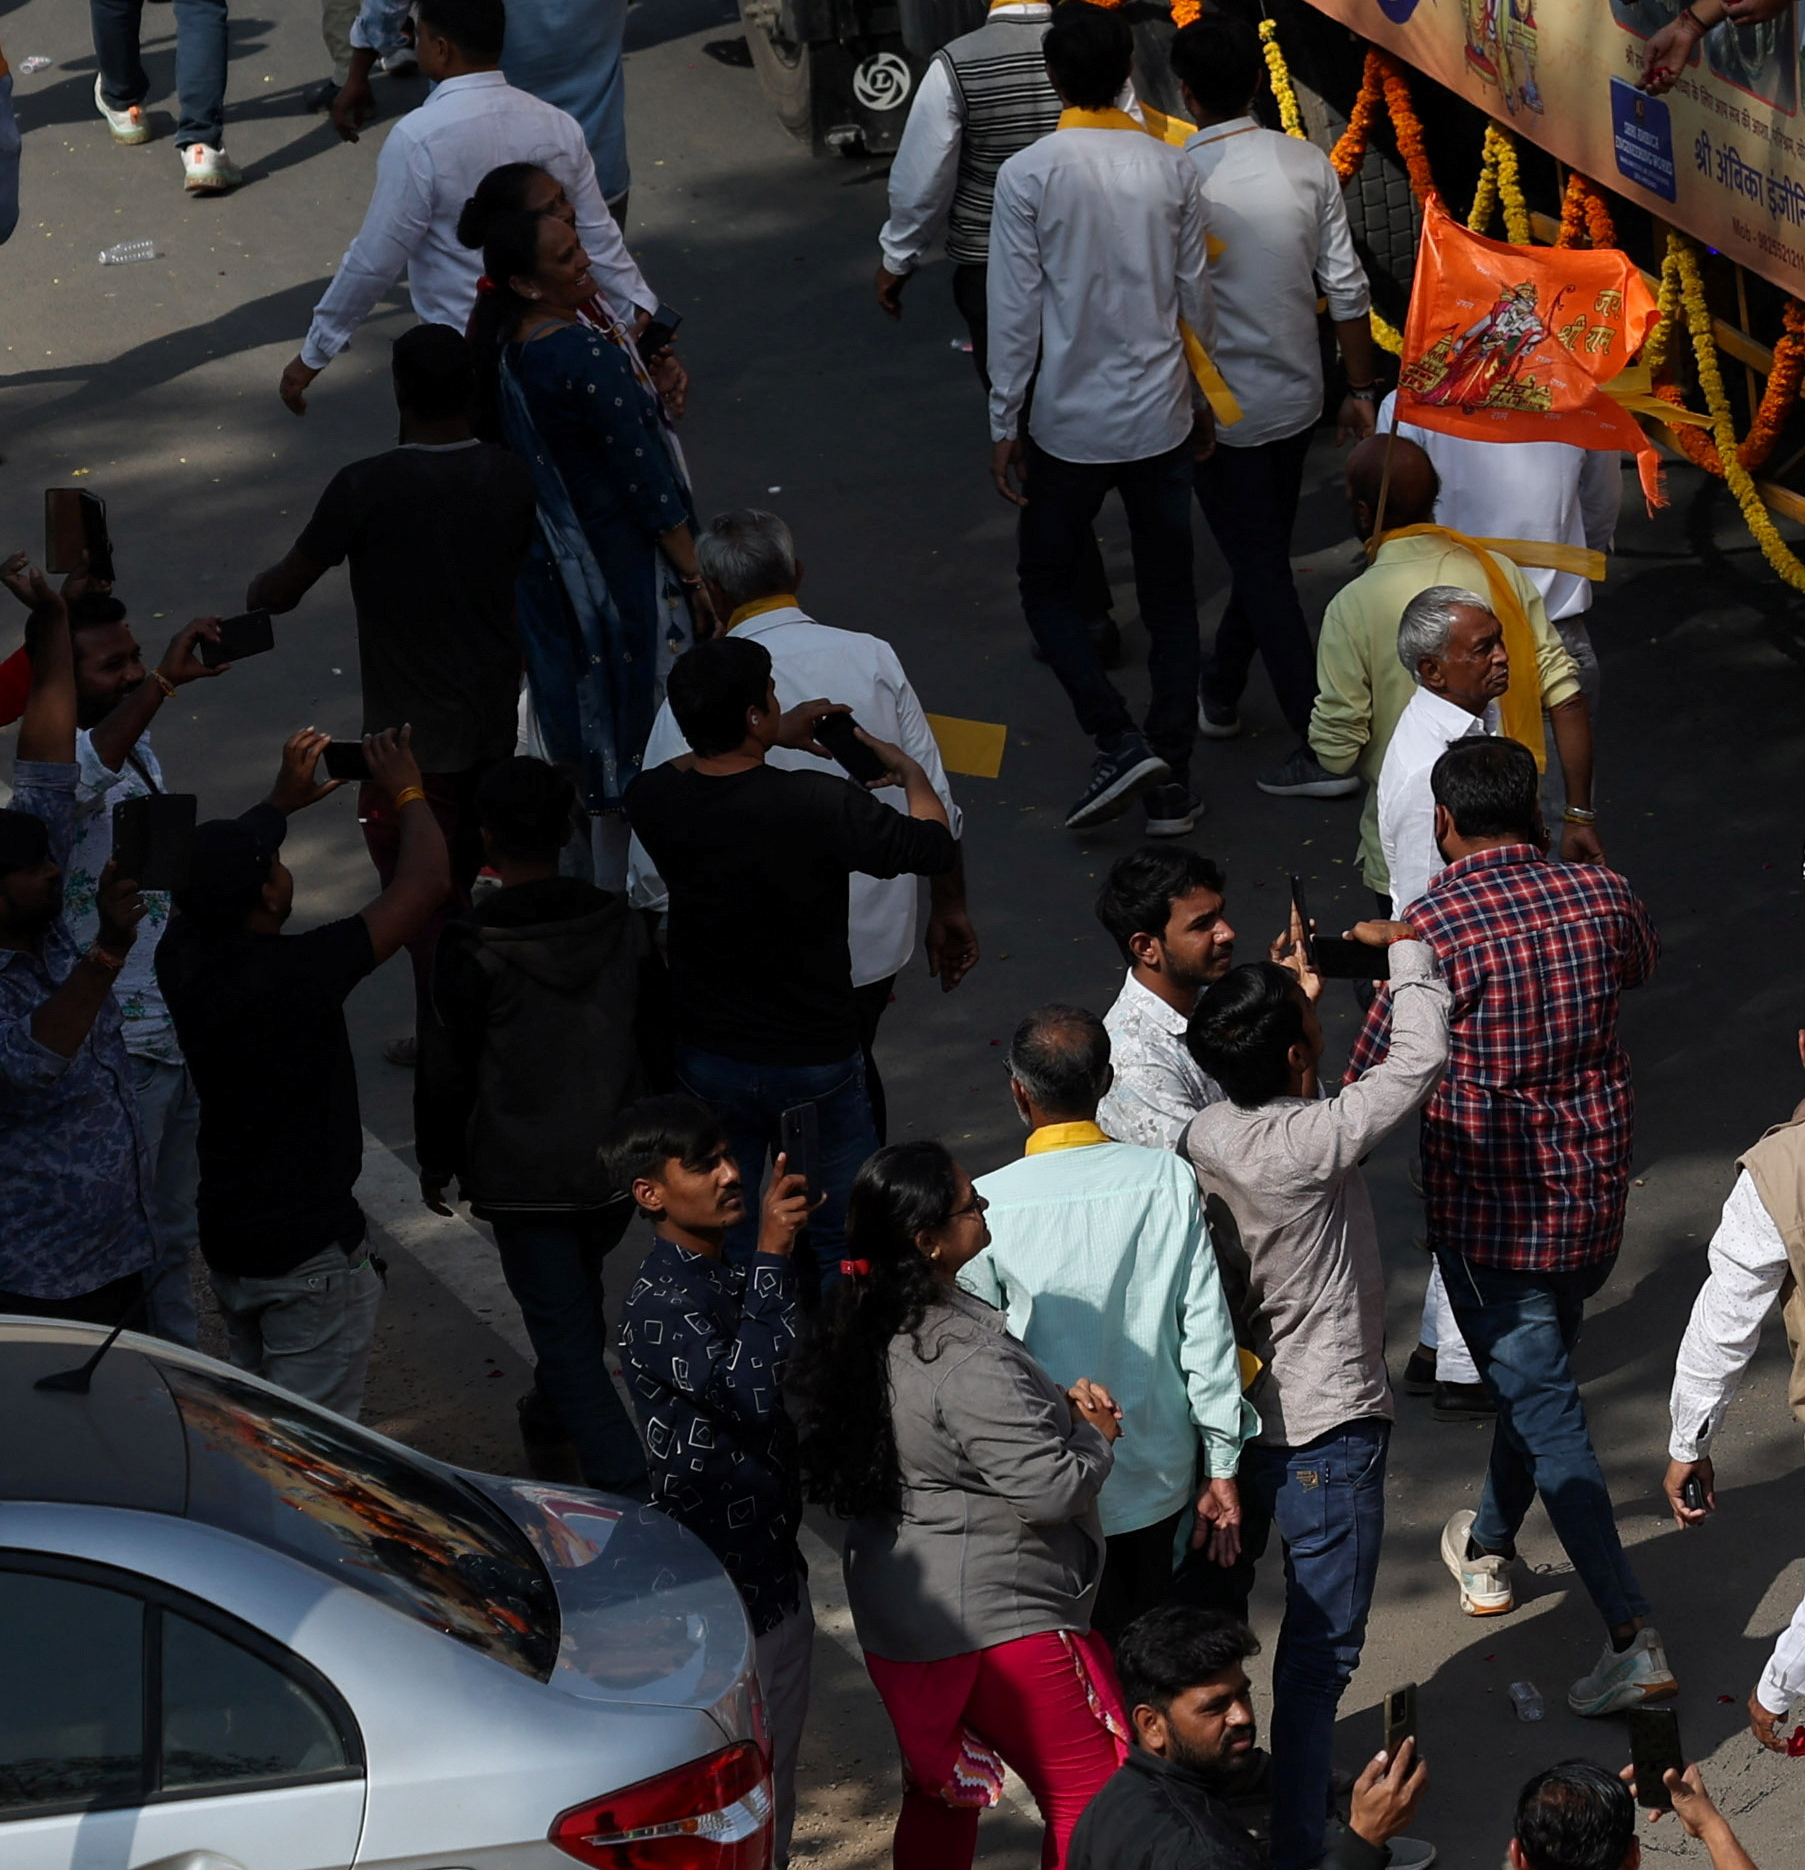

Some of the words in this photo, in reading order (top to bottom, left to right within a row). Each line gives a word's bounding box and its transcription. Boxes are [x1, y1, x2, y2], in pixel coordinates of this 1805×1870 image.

[1694, 130, 1712, 178] श्री
[1717, 143, 1764, 206] अंबिका
[1593, 289, 1622, 320] जय
[1557, 315, 1586, 353] श्री
[1585, 326, 1616, 355] राम
